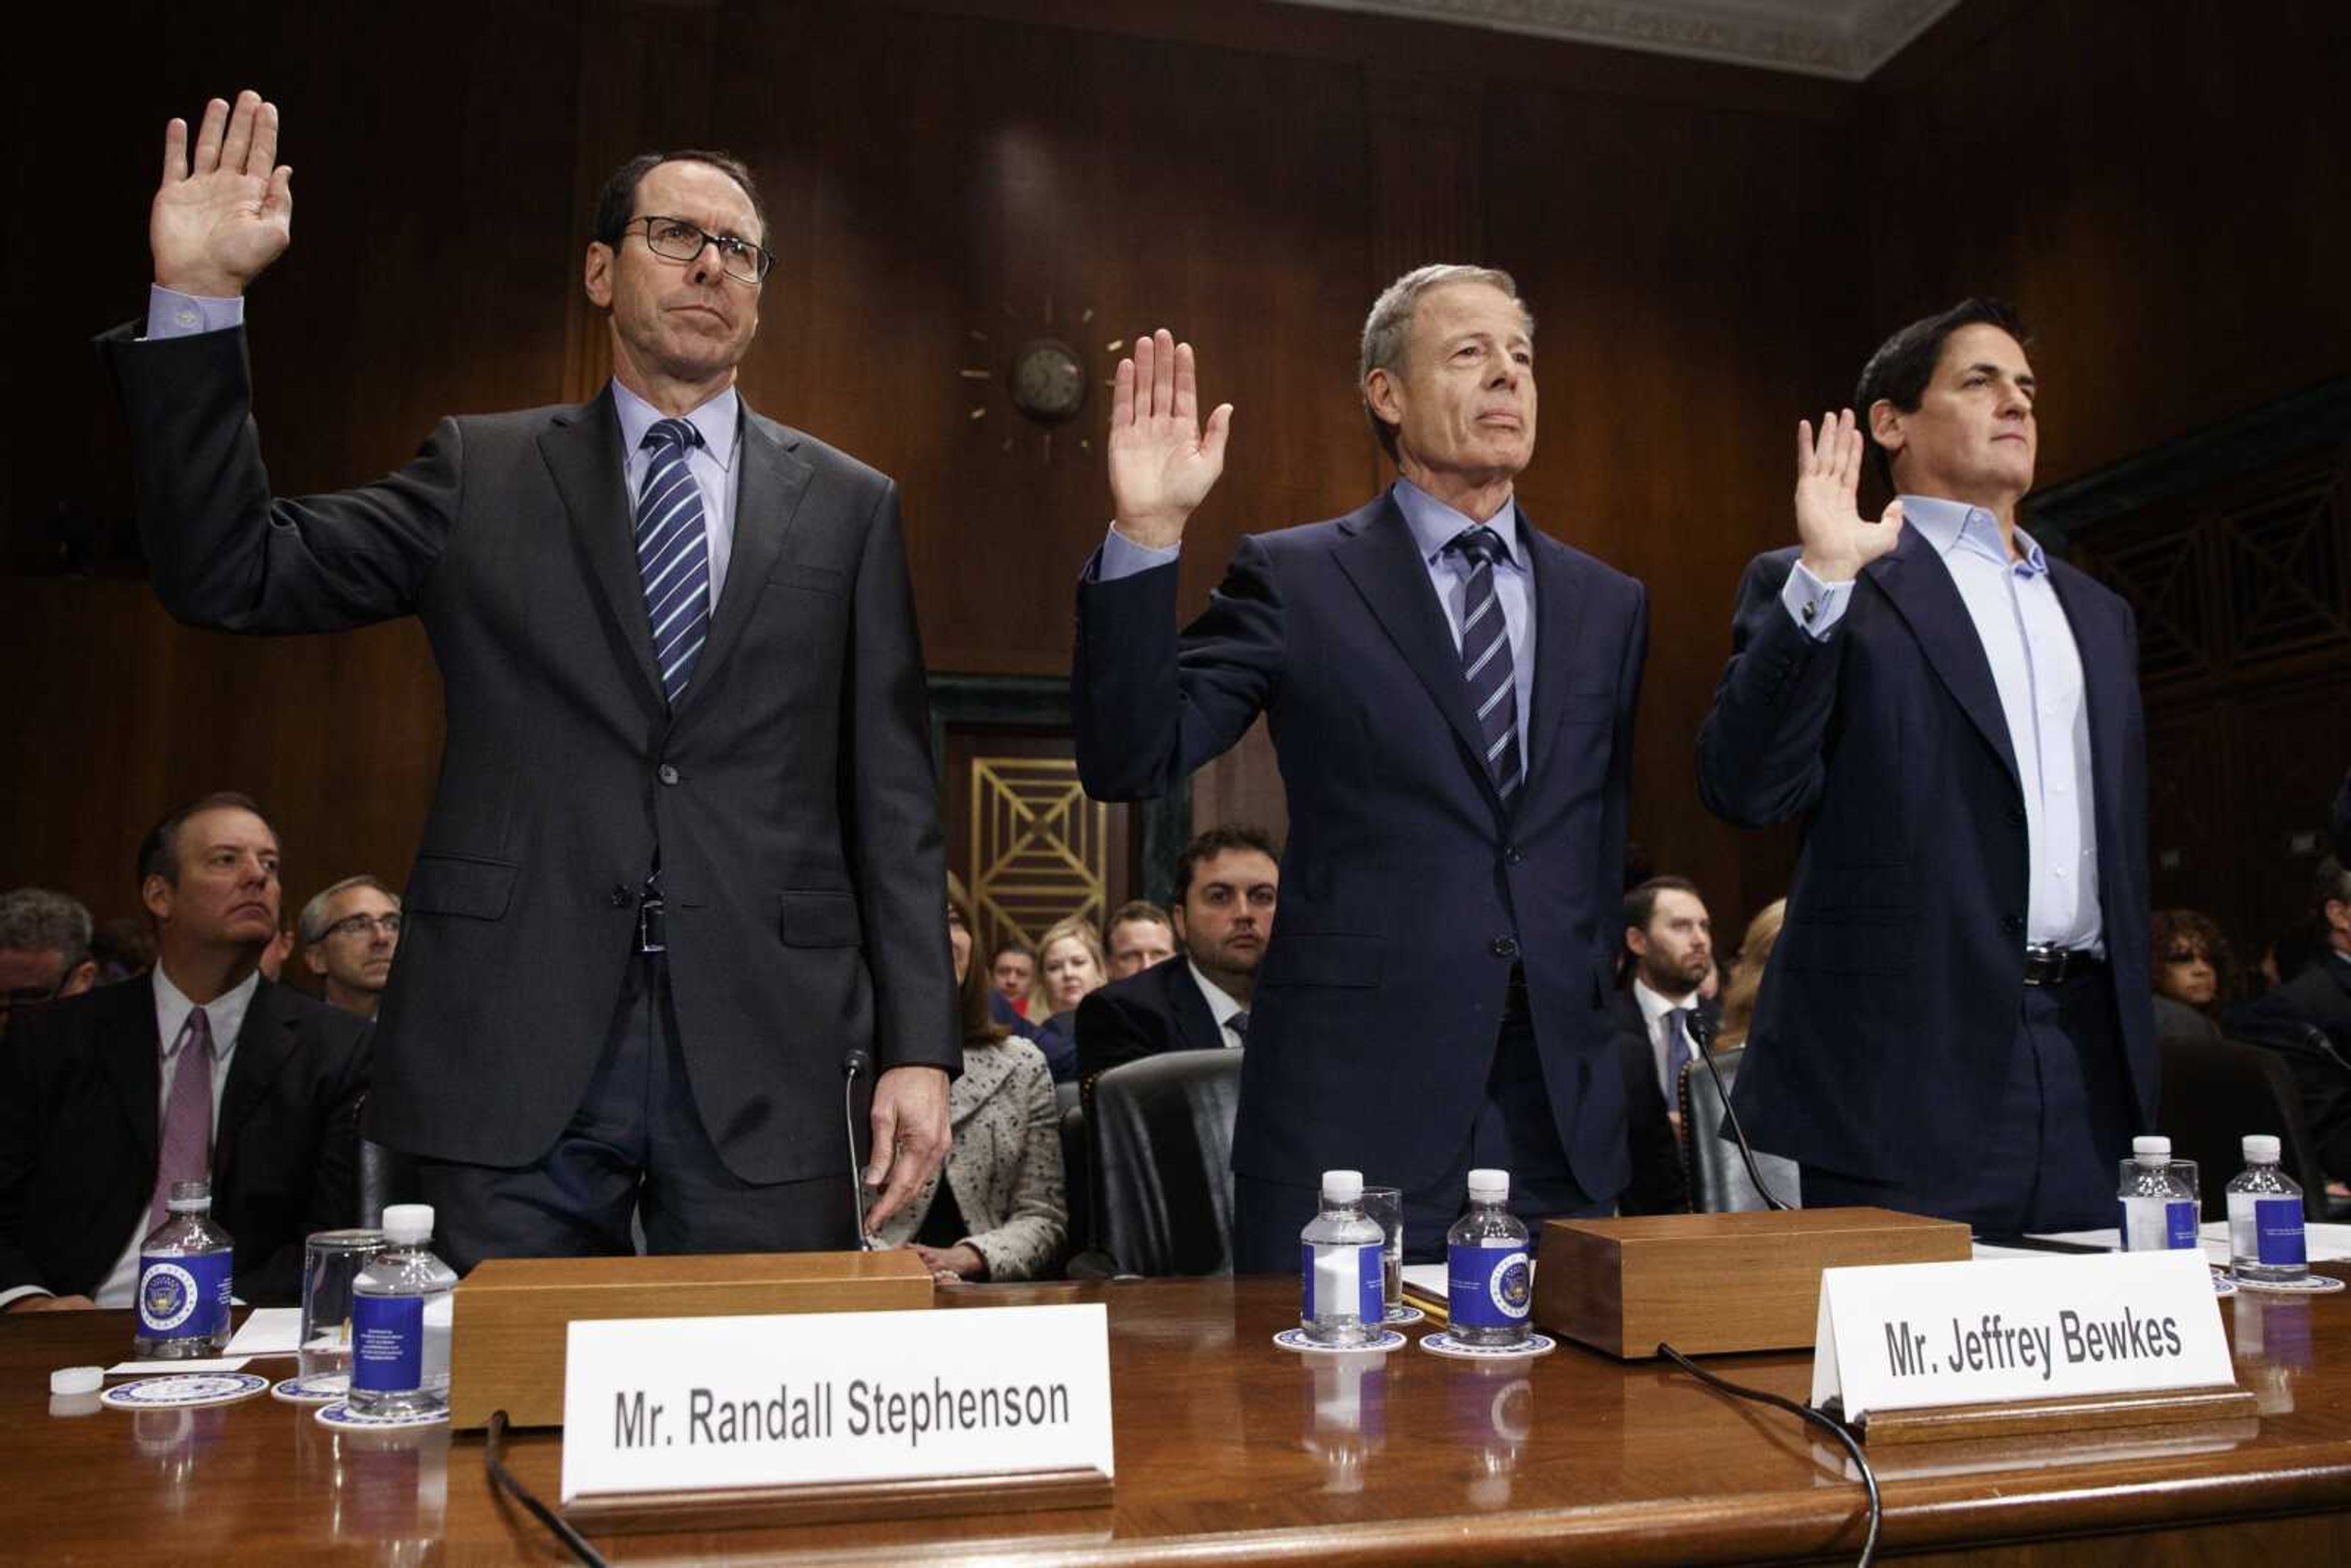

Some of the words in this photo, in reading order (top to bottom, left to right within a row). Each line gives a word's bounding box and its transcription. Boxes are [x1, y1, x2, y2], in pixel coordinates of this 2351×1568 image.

[1884, 1321, 1938, 1377] Mr.
[1948, 1314, 2052, 1381] Jeffrey
[2059, 1305, 2182, 1364] Bewkes
[615, 1390, 672, 1447] Mr.
[689, 1382, 831, 1444] Randall
[847, 1376, 1069, 1447] Stephenson
